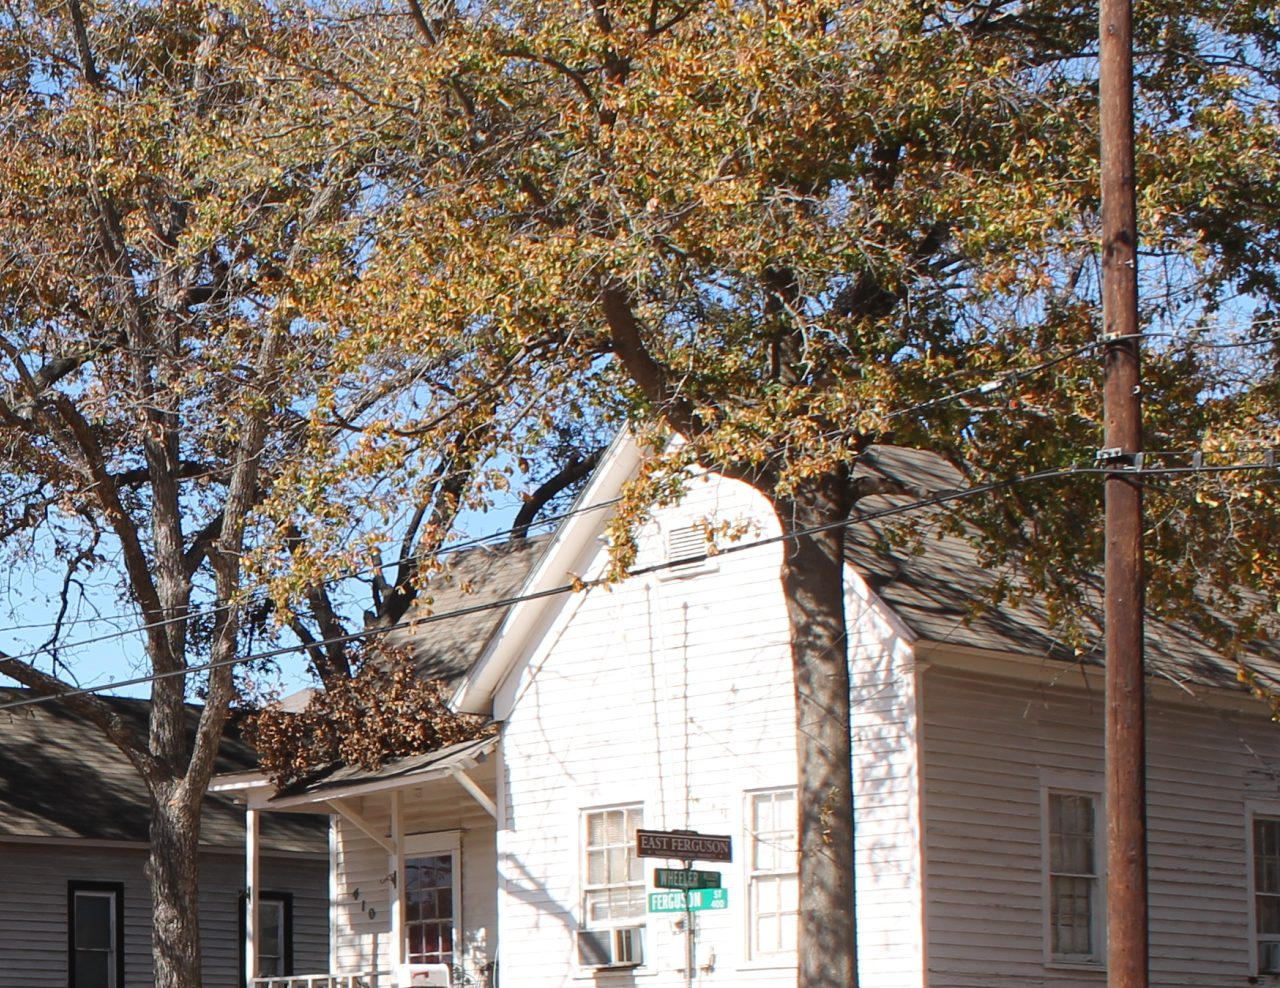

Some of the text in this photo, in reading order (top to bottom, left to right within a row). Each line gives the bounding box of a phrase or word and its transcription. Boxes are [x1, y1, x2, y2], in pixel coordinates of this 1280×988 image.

[641, 836, 729, 853] EAST FERGUSON
[660, 870, 698, 886] WHEELER
[352, 887, 376, 920] 410
[651, 889, 723, 910] FERGUSON ST
